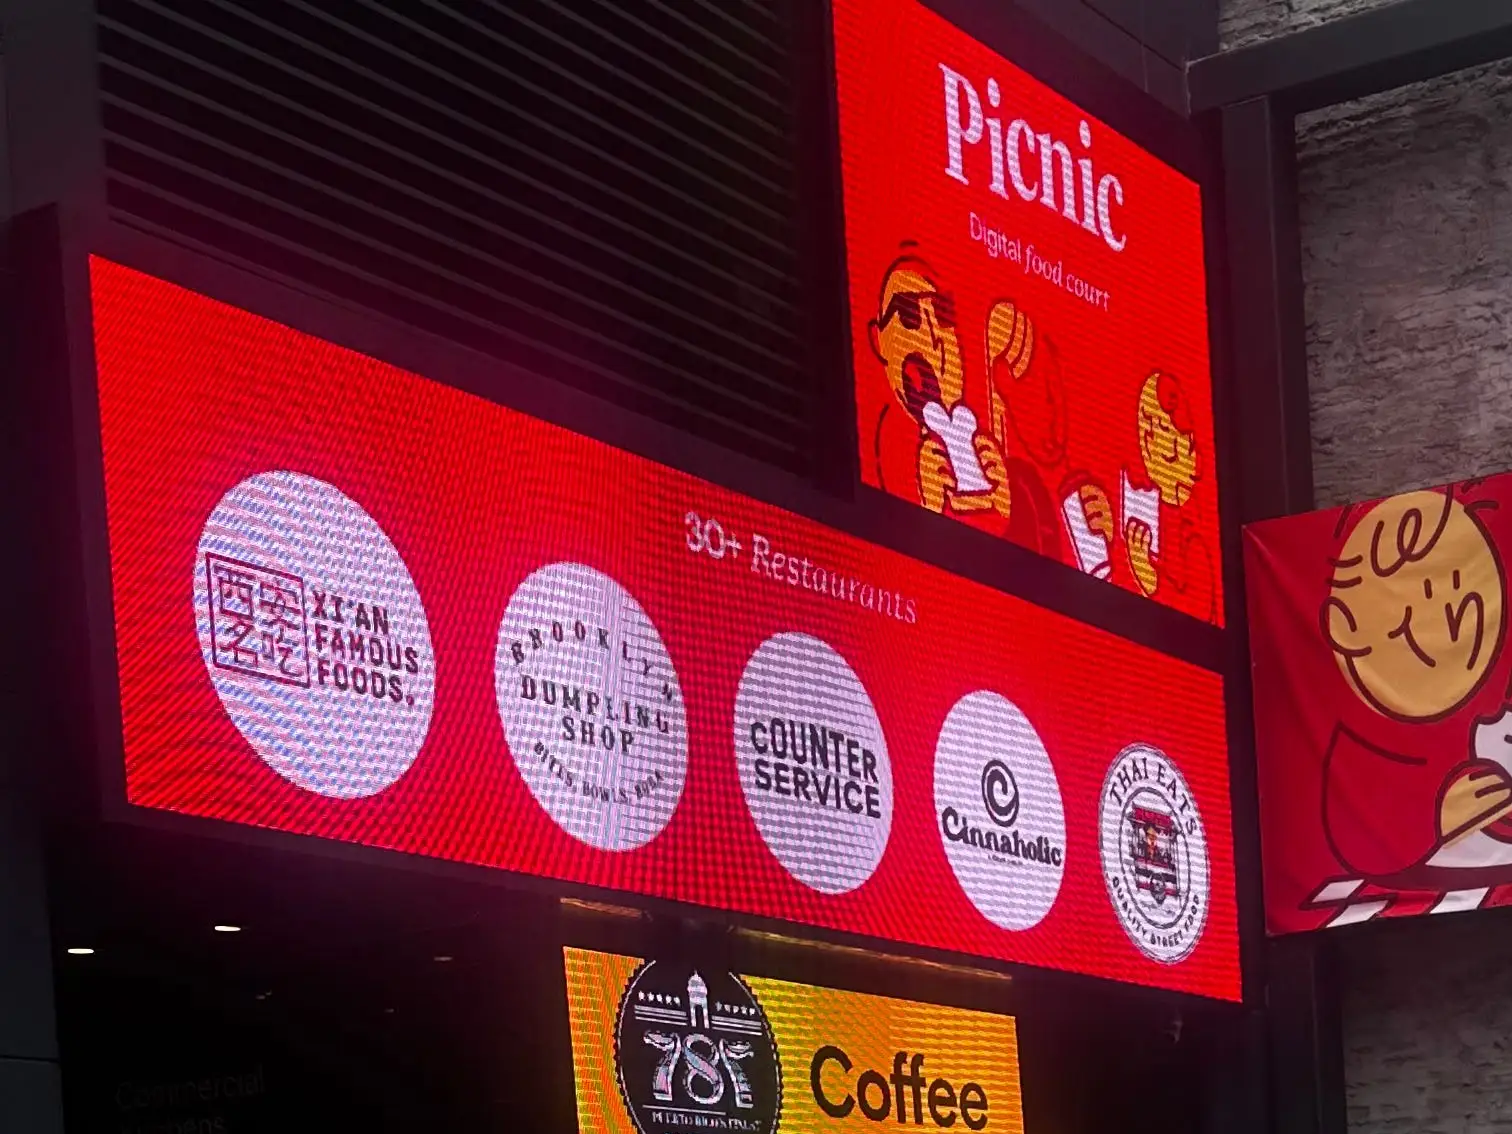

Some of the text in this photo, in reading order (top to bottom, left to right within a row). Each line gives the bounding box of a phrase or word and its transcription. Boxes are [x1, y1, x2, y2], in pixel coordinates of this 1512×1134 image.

[939, 63, 1126, 251] Picnic
[970, 212, 1110, 311] Digital food court
[685, 512, 916, 624] 30+ Restaurants
[314, 623, 419, 673] FAMOUS
[511, 620, 673, 700] BROOKLYN
[318, 658, 415, 705] FOODS.
[521, 675, 669, 734] DUMPLING
[562, 716, 634, 753] SHOP
[750, 717, 878, 784] COUNTER
[754, 758, 881, 819] SERVICE
[1110, 757, 1198, 835] THAI EATS
[941, 806, 1062, 868] Cinnaholic
[1150, 929, 1184, 947] STREET
[810, 1046, 989, 1131] Coffee
